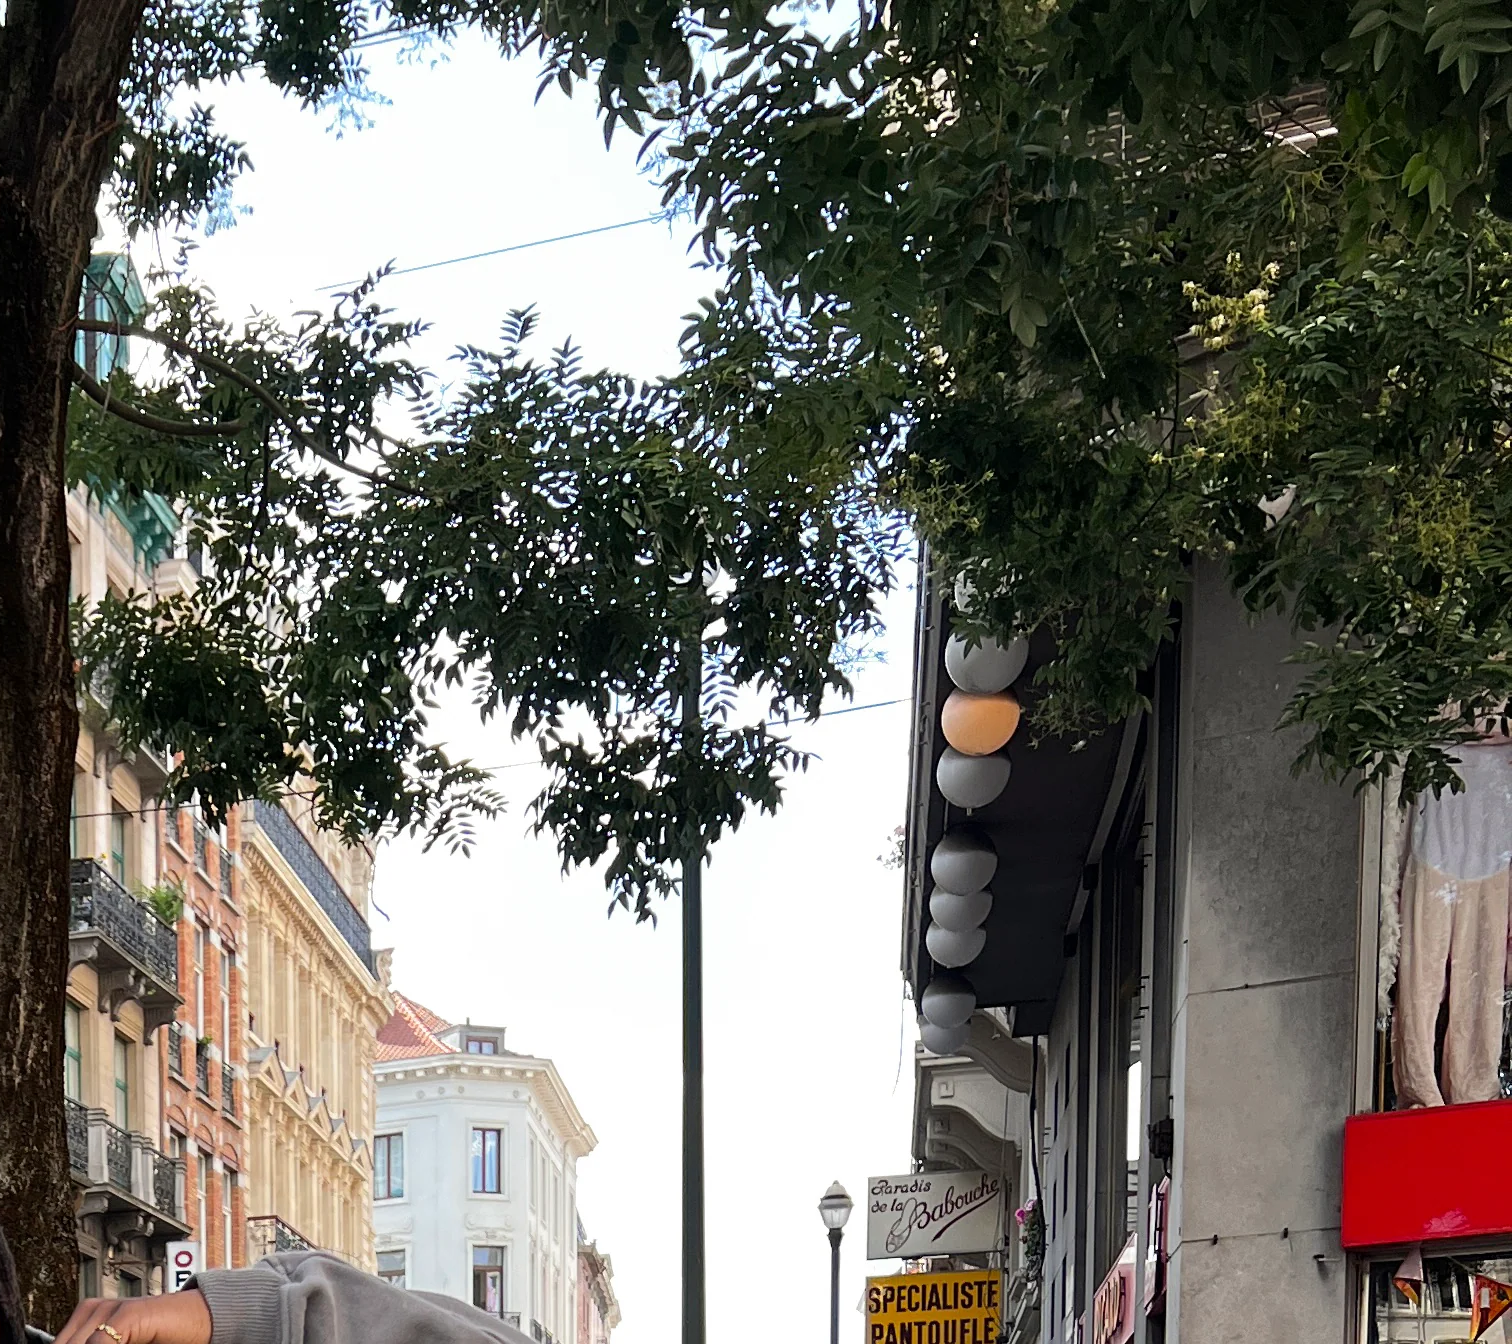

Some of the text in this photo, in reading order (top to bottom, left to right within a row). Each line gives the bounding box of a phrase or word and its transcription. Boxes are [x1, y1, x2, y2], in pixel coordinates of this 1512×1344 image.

[871, 1179, 932, 1195] Paradis
[871, 1173, 1000, 1229] de la Babouche
[868, 1280, 999, 1314] SPECIALISTE
